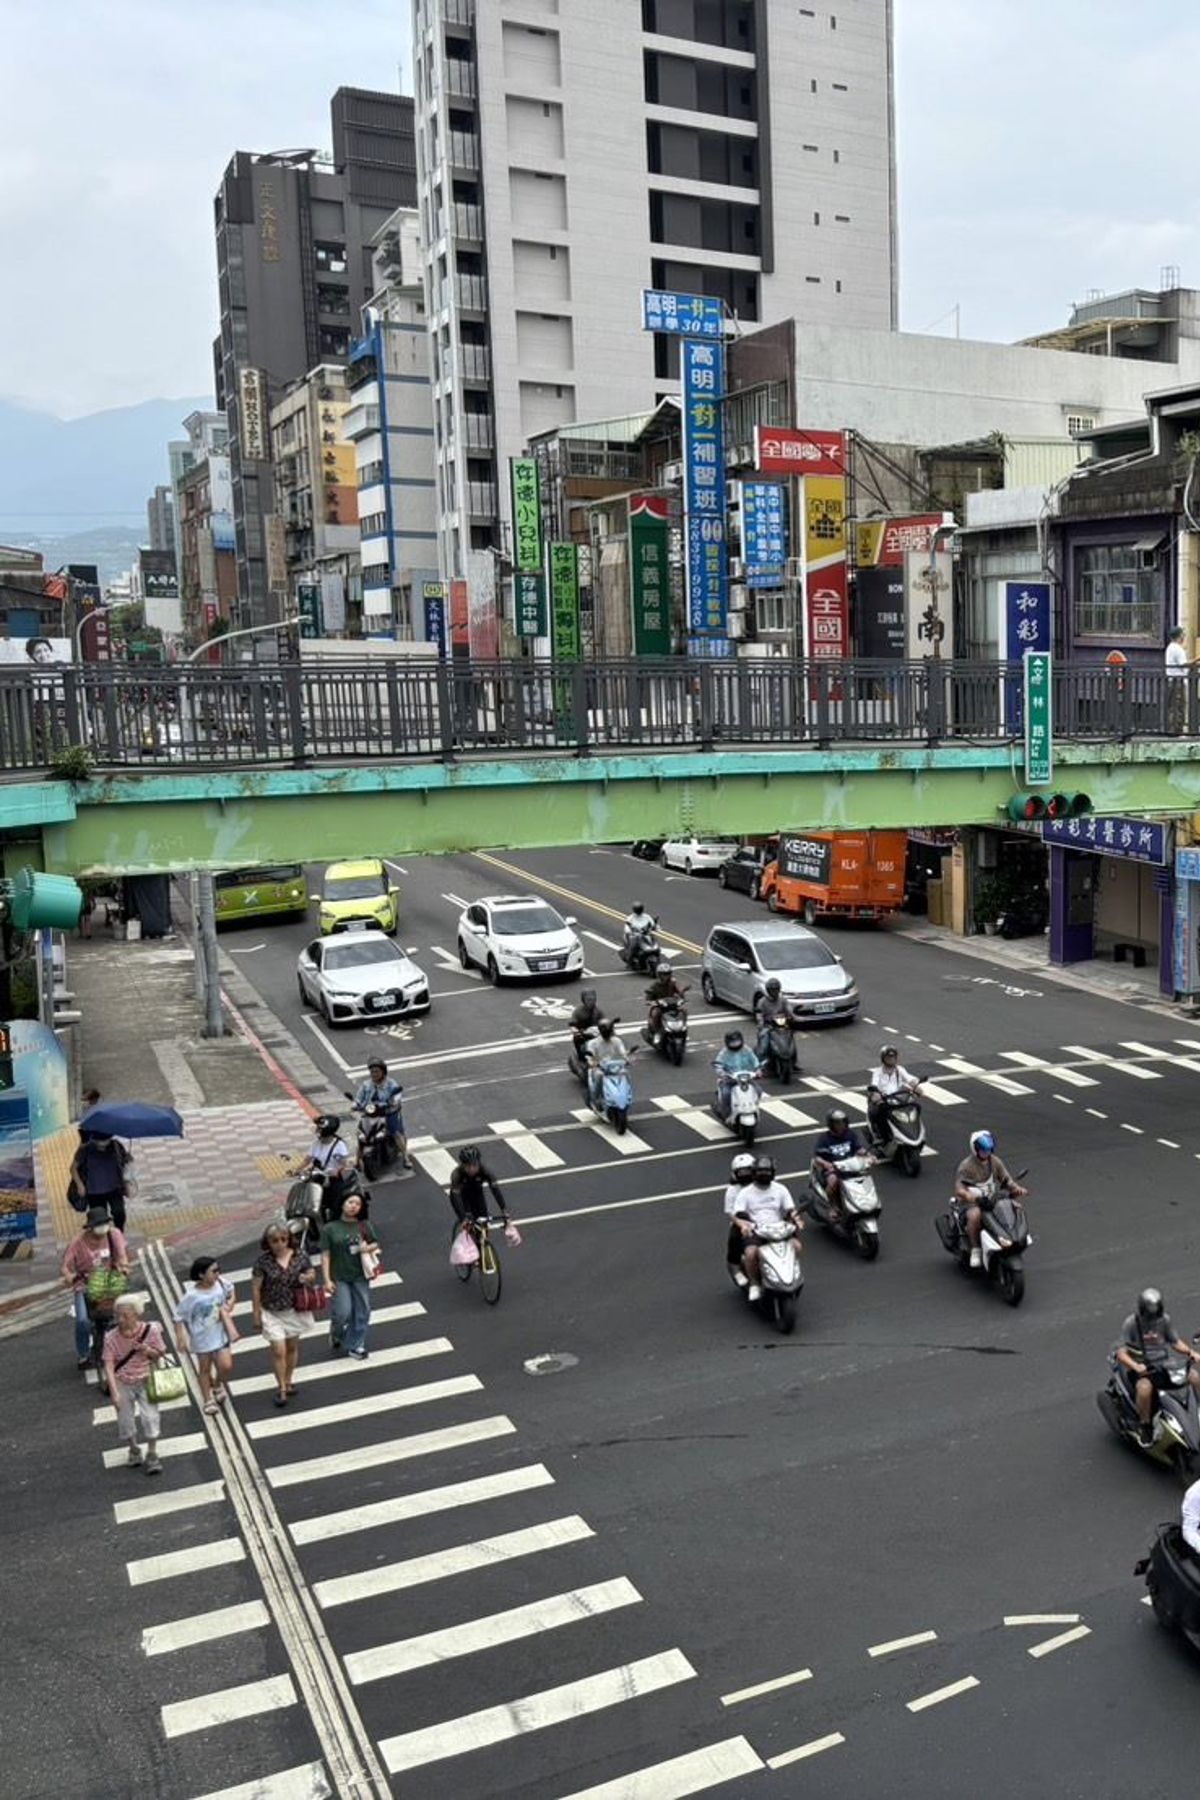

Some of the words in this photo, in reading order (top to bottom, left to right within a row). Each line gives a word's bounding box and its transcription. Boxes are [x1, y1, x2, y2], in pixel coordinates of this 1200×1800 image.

[646, 293, 718, 319] 高明一對一
[690, 345, 717, 510] 高明一對一補習班
[641, 544, 661, 630] 信義房屋
[784, 839, 827, 858] KERRY
